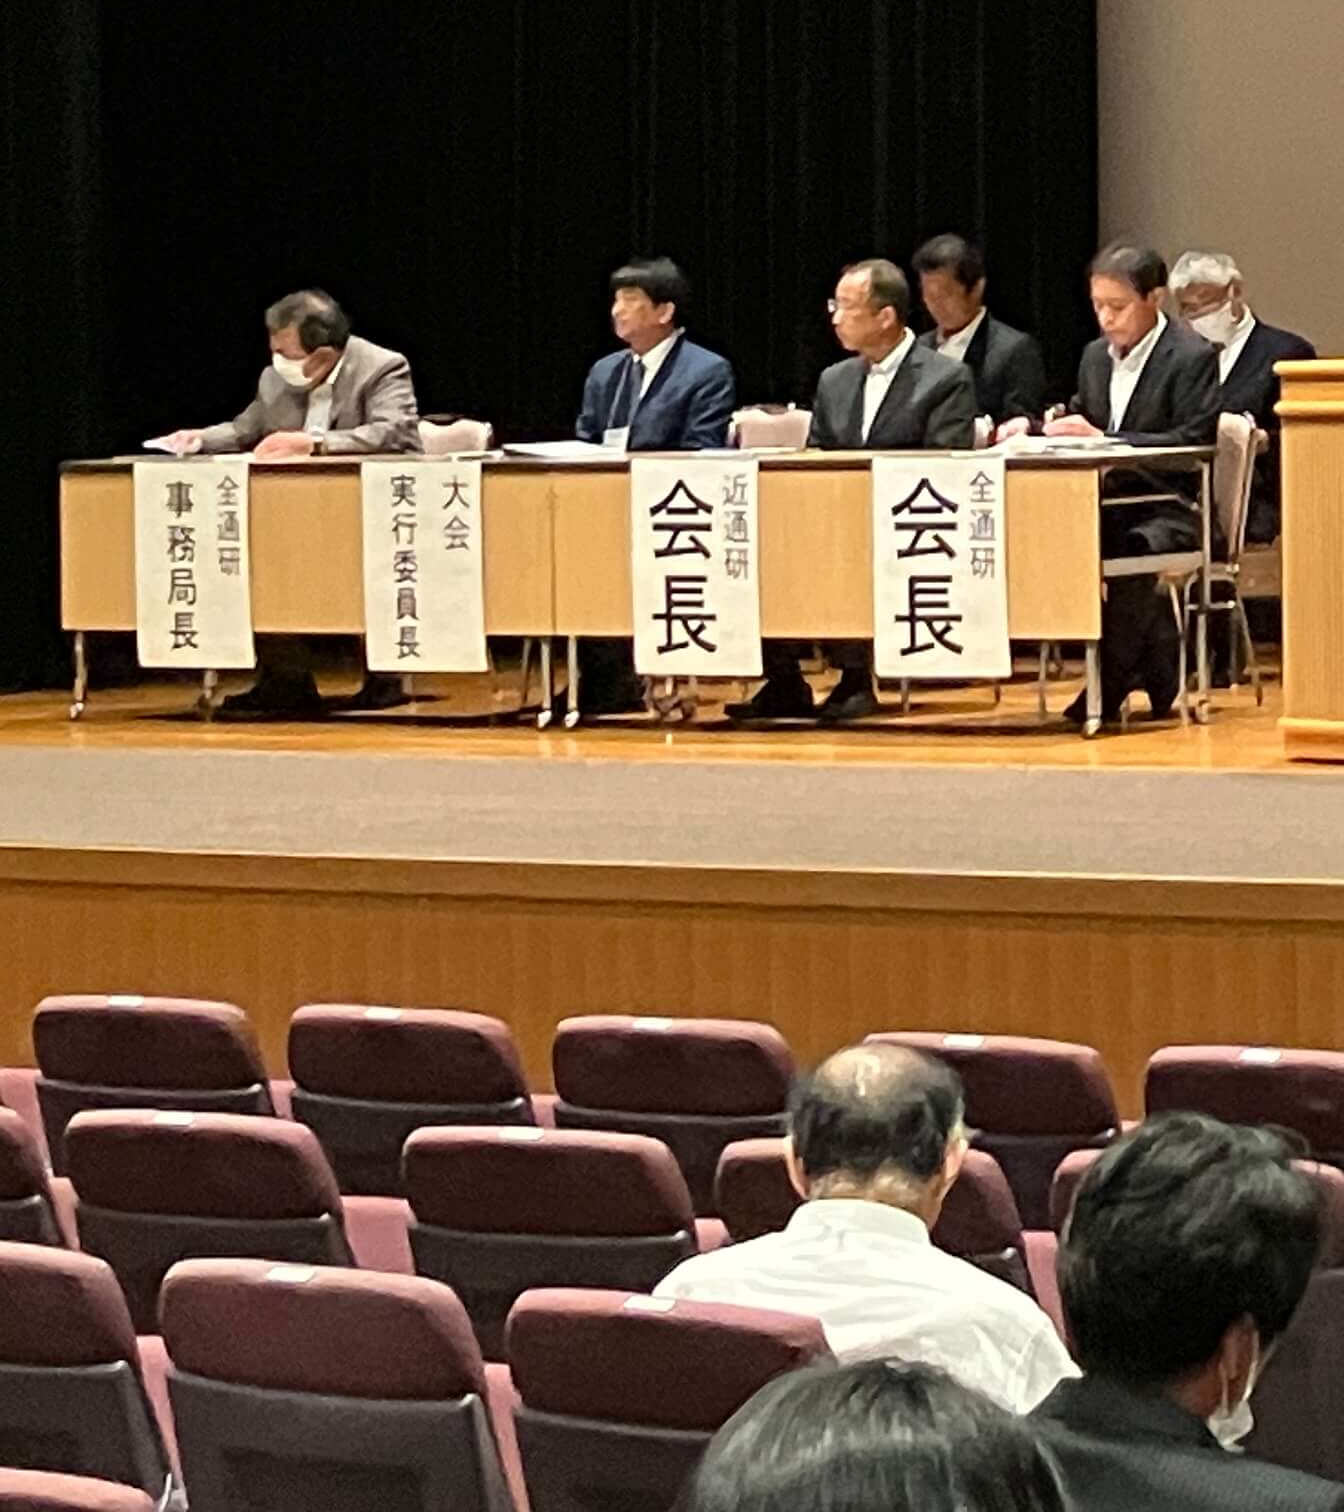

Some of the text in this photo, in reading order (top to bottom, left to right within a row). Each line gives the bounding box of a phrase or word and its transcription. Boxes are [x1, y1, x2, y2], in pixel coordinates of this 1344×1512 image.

[166, 480, 199, 650] 事務局長
[390, 474, 421, 660] 実行委員長
[442, 475, 470, 551] 大会
[649, 479, 717, 655] 会長
[722, 473, 750, 580] 近通研
[890, 477, 964, 657] 会長
[968, 470, 997, 579] 全通研
